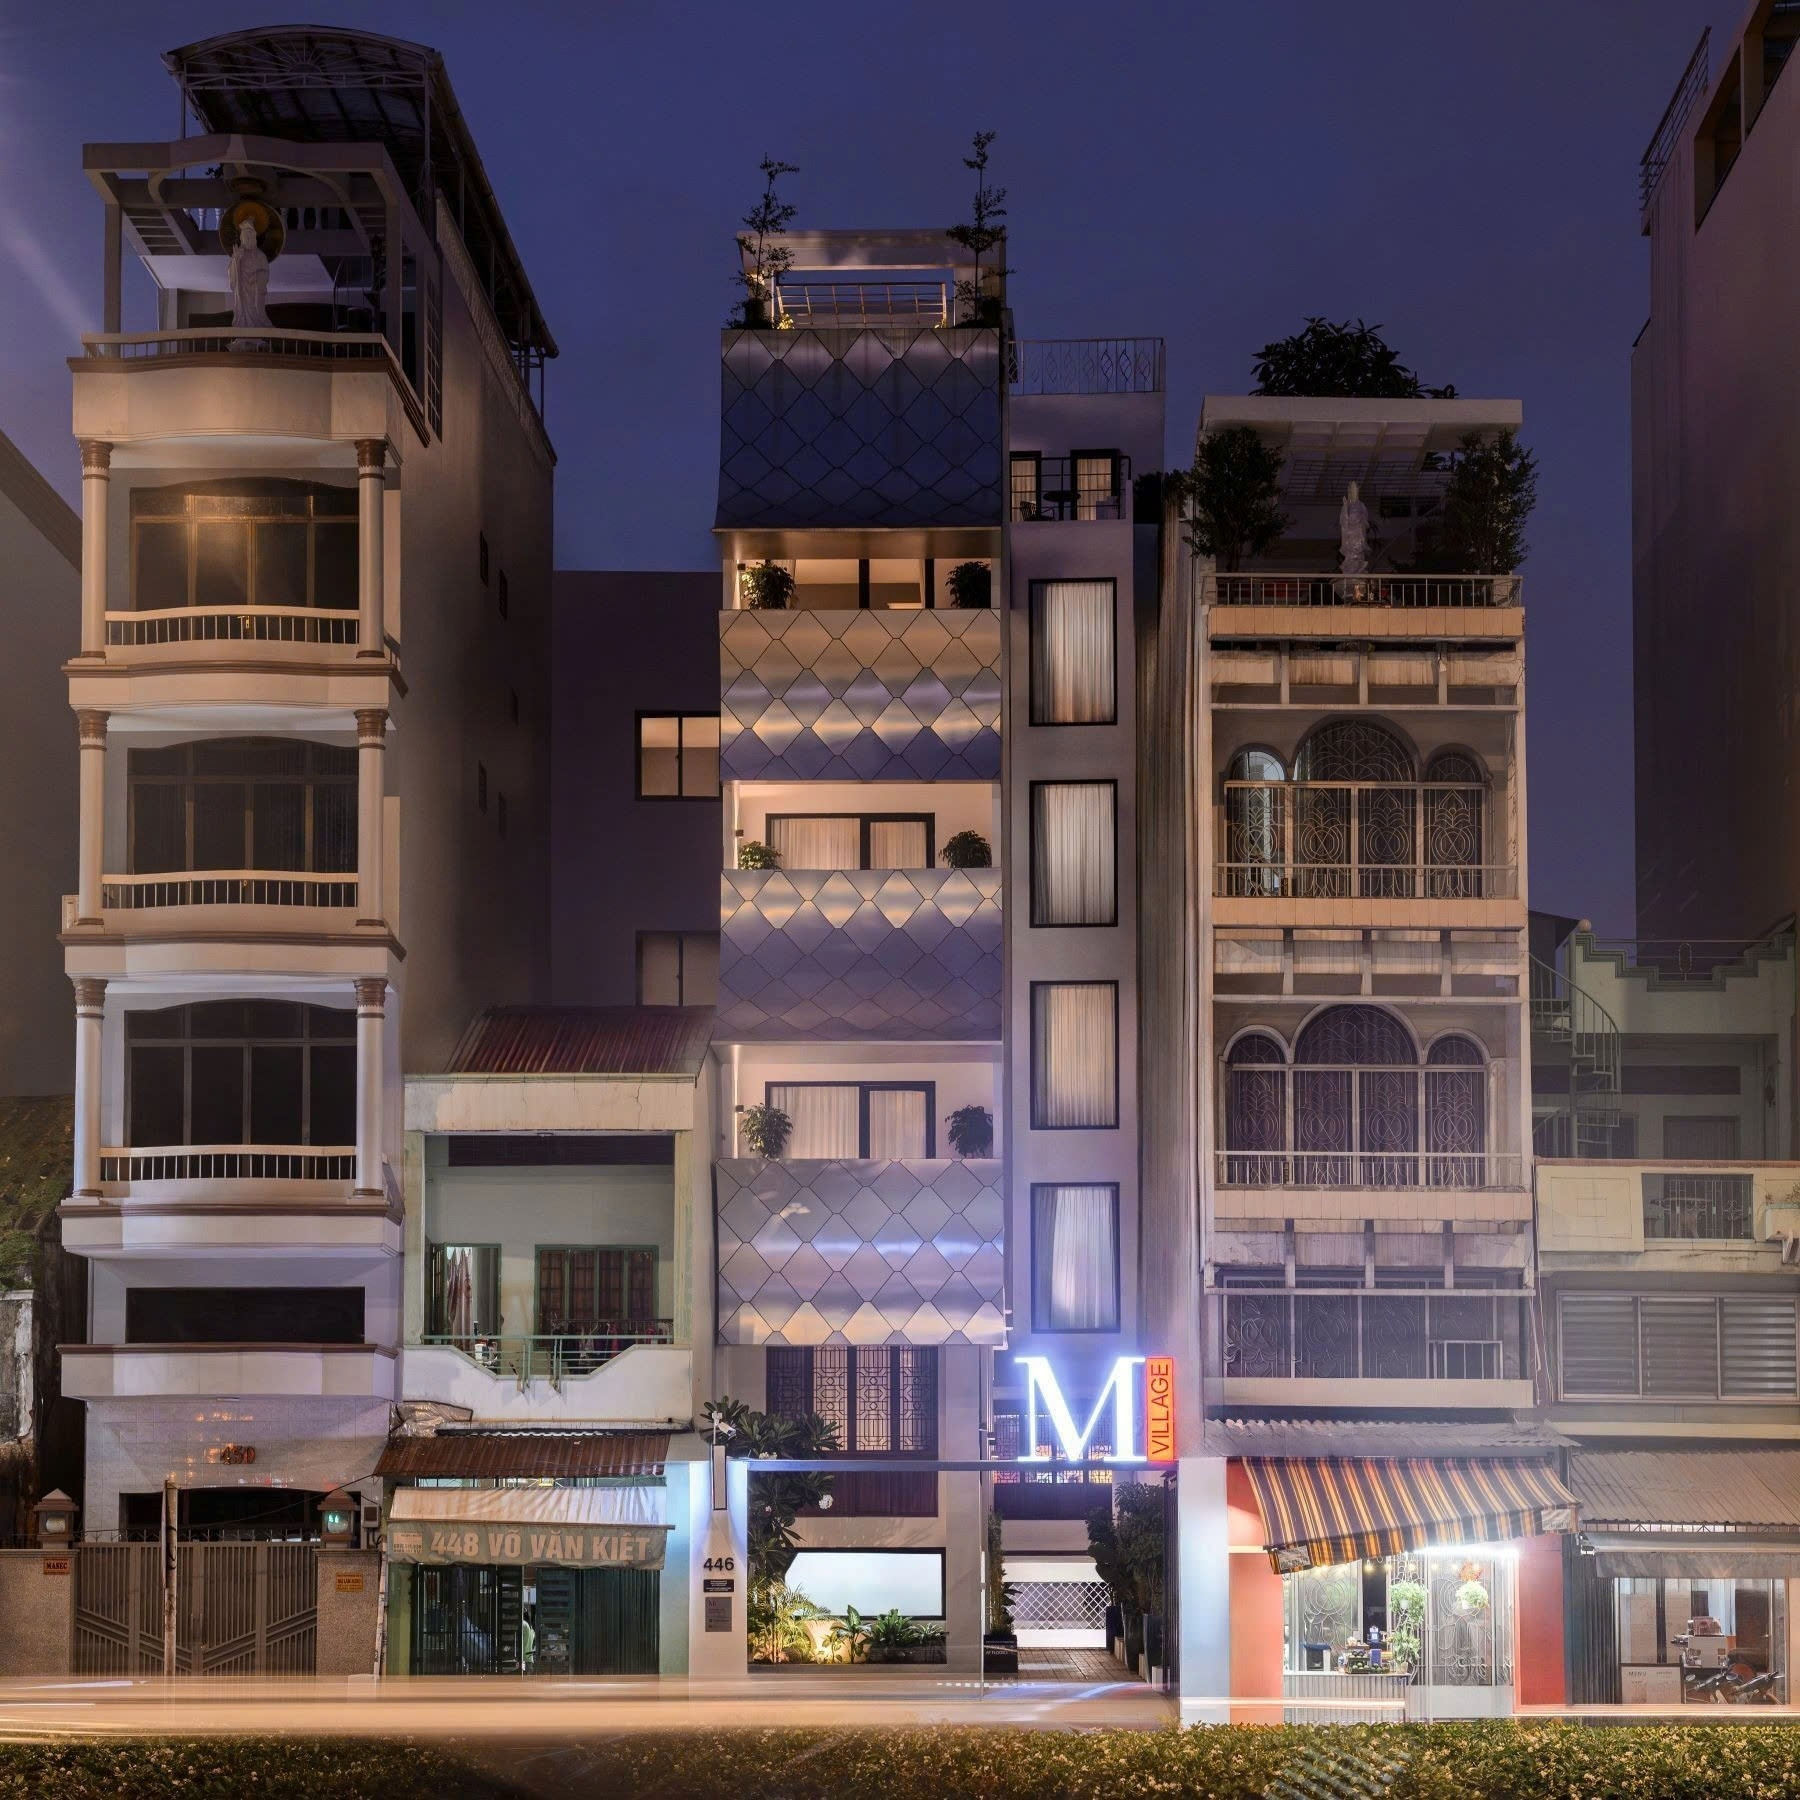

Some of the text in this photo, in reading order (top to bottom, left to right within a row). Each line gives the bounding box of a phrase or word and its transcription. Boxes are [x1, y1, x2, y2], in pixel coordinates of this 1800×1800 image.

[1013, 1356, 1147, 1462] M
[1150, 1363, 1170, 1455] VILLAGE
[220, 1445, 256, 1465] 450
[430, 1532, 479, 1557] 448
[488, 1529, 522, 1558] VÕ
[530, 1530, 584, 1559] VĂN
[703, 1557, 735, 1572] 446
